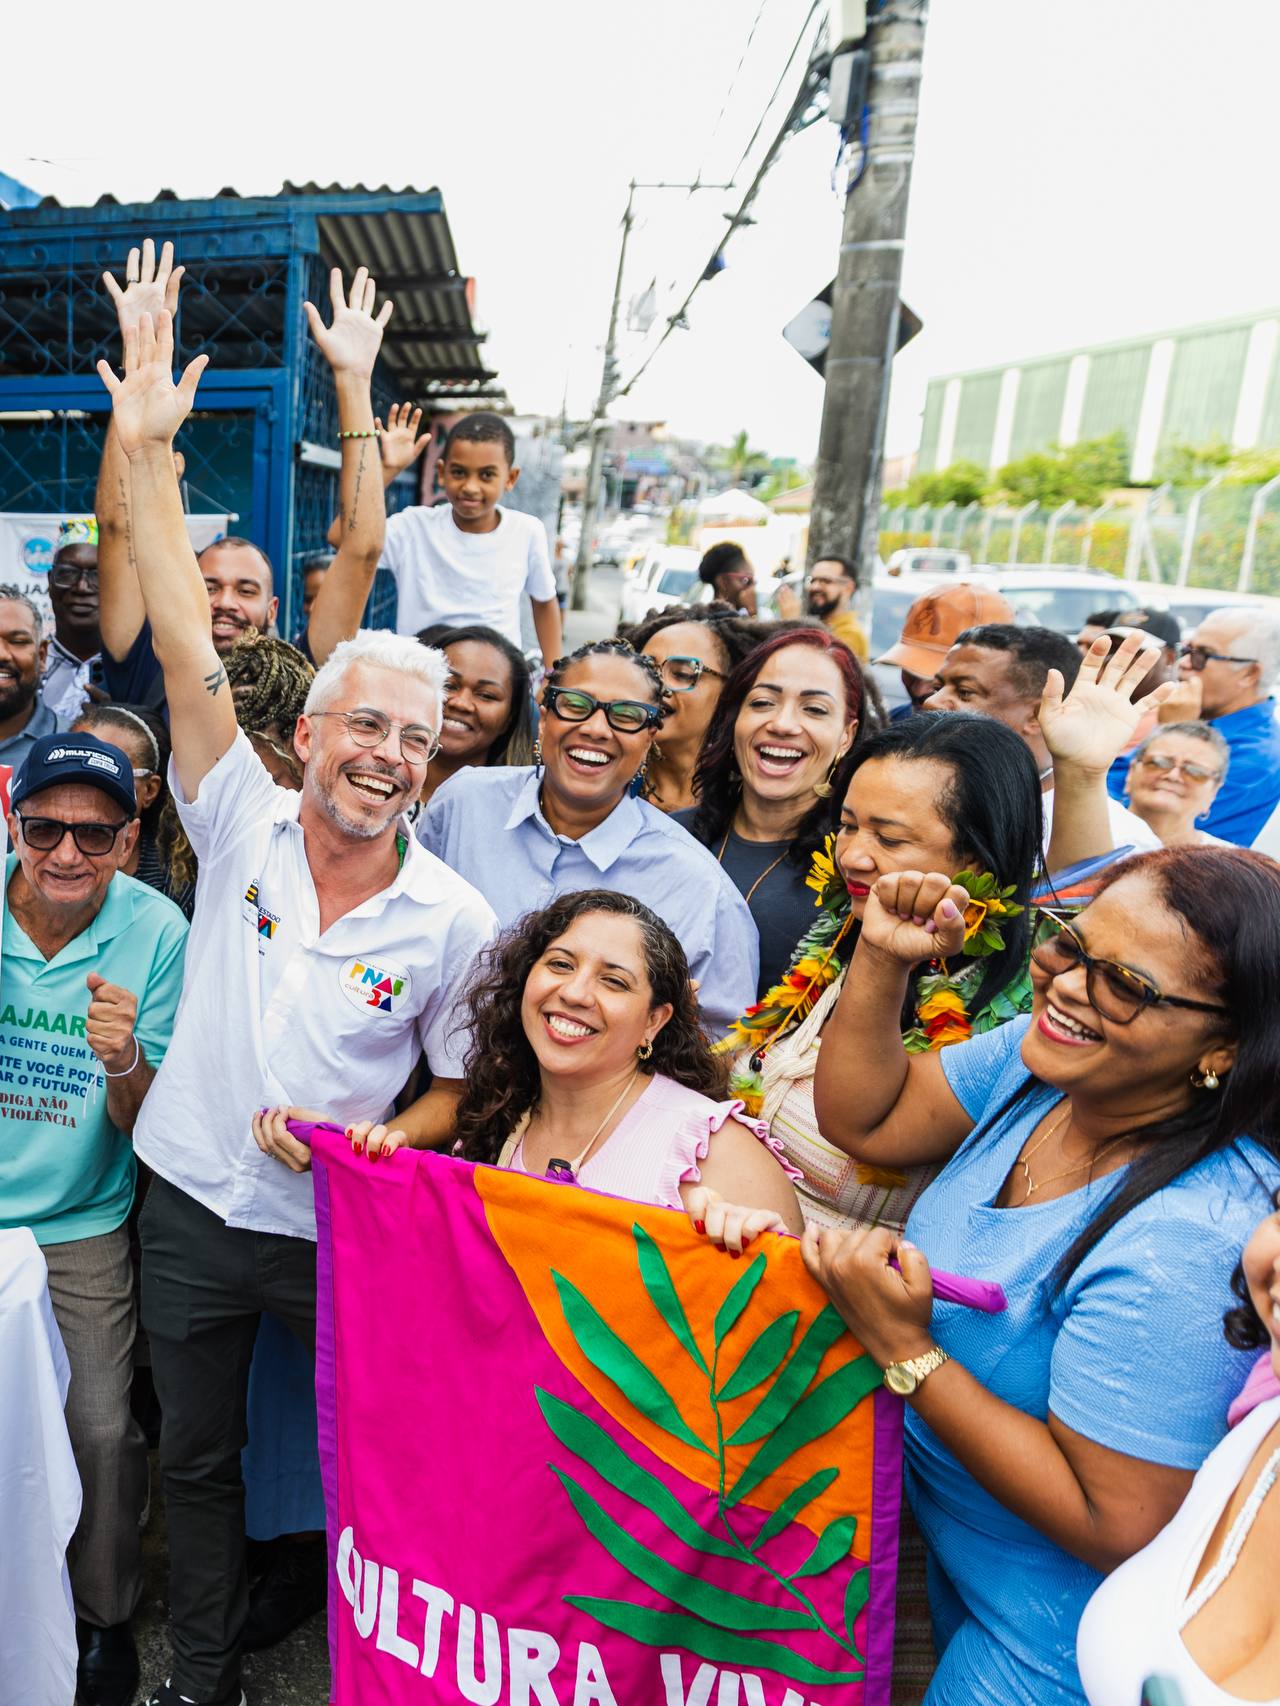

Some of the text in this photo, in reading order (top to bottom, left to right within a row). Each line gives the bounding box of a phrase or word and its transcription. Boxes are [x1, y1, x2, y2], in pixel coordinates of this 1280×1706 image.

[0, 1004, 87, 1039] AJAAR
[9, 1036, 48, 1053] GENTE
[51, 1044, 86, 1060] QUEM
[26, 1059, 66, 1077] VOCÊ
[67, 1068, 105, 1089] PODE
[18, 1075, 29, 1086] O
[32, 1077, 88, 1099] FUTURO
[0, 1092, 69, 1111] DIGA NÃO
[0, 1107, 77, 1129] VIOLÊNCIA
